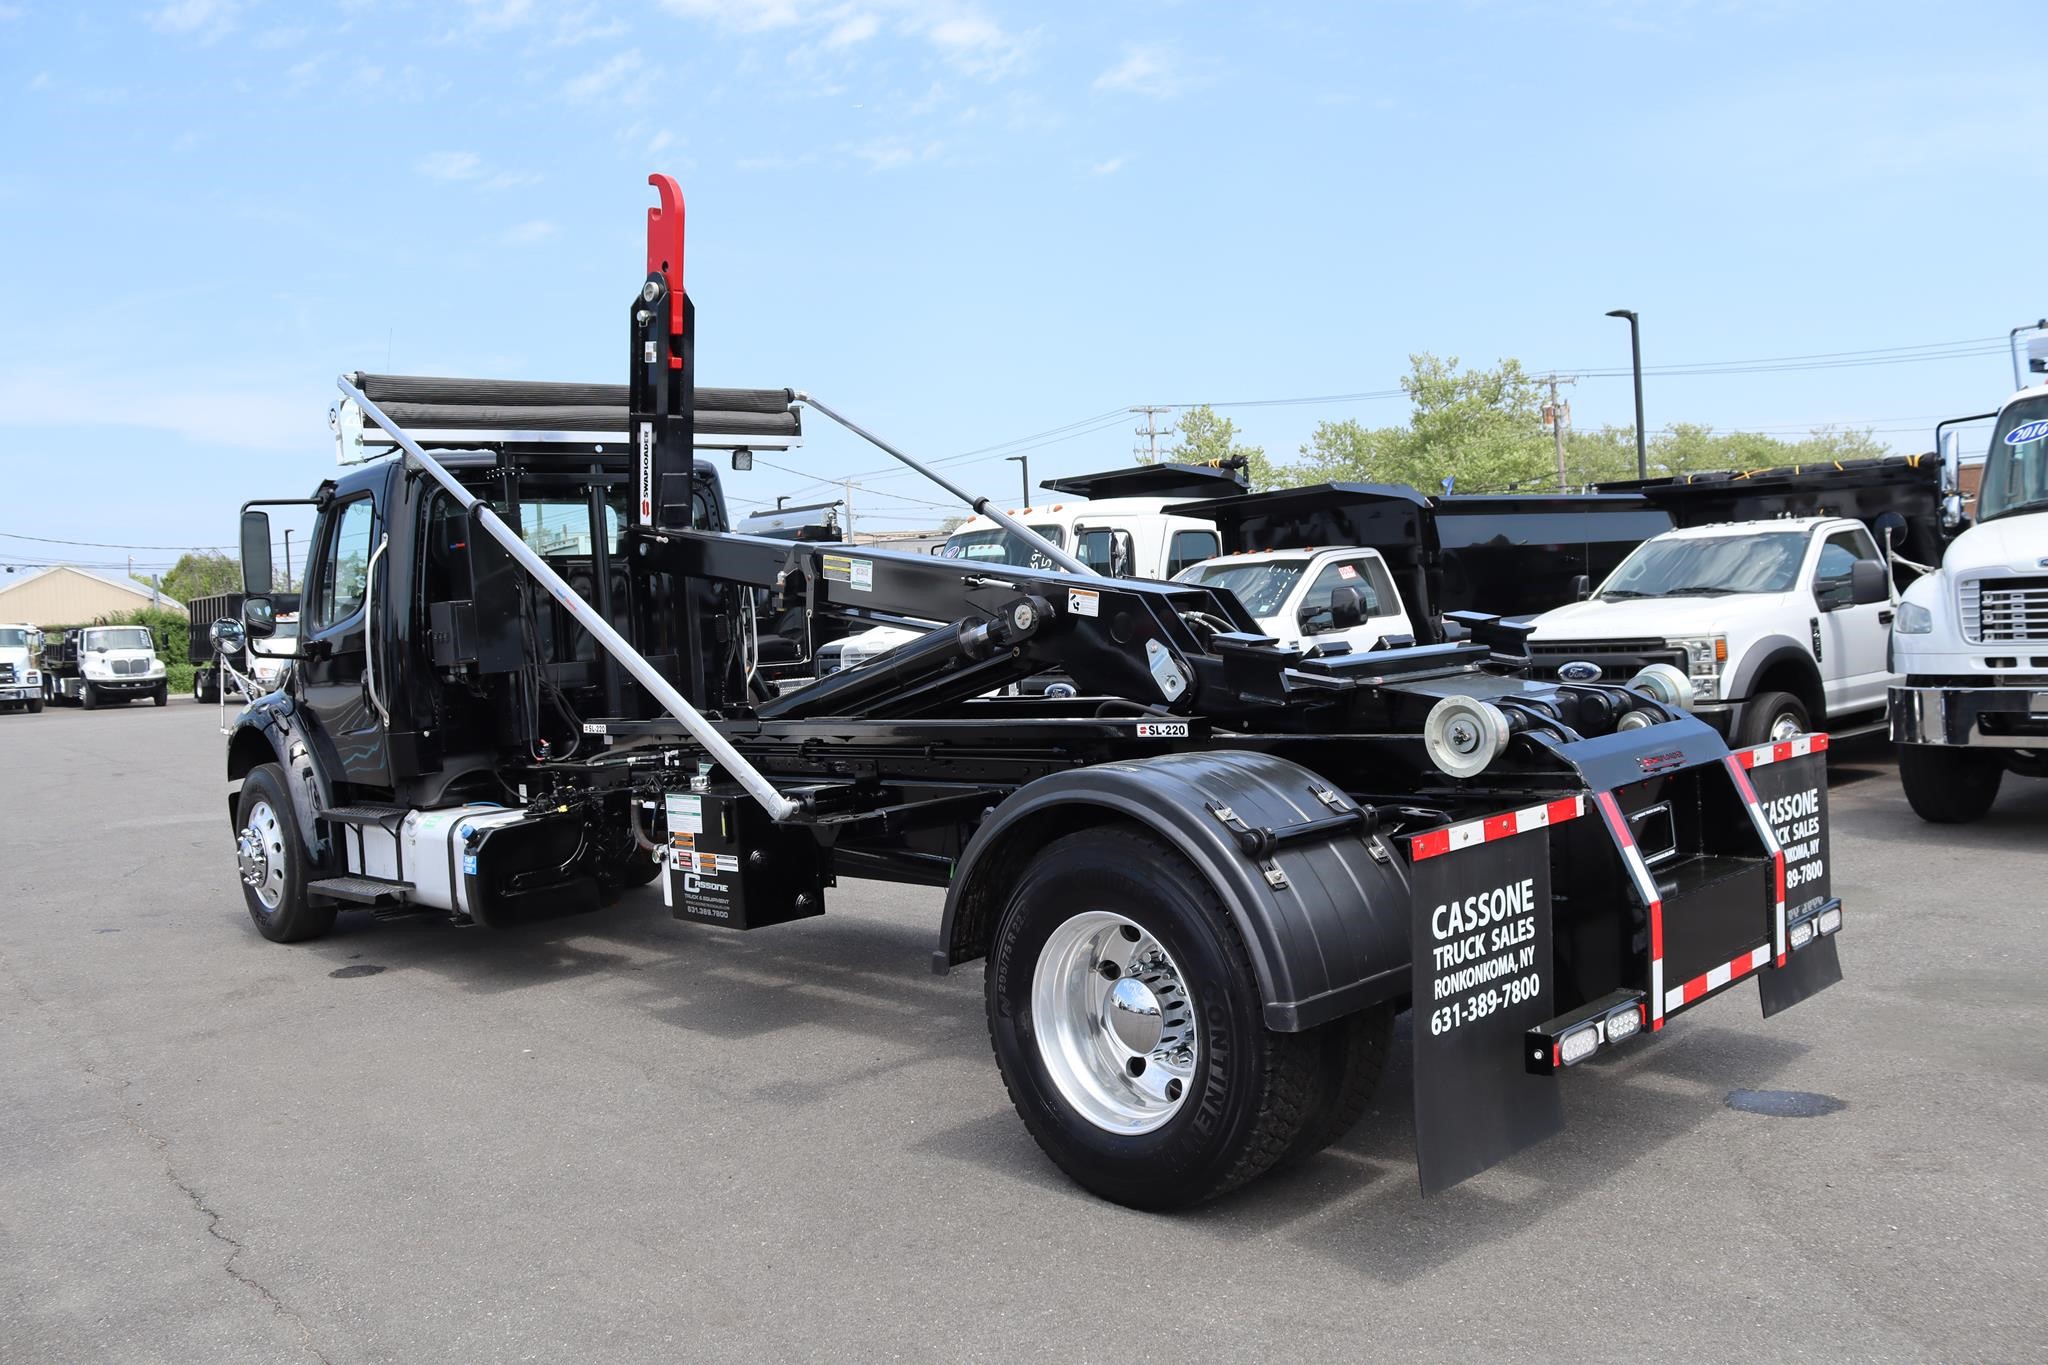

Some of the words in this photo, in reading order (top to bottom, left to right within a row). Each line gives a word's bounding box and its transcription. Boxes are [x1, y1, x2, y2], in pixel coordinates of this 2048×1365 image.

[2012, 422, 2048, 443] 2016
[1568, 667, 1592, 678] Ford
[1148, 725, 1185, 735] SL-220
[1793, 816, 1820, 841] SALES
[1810, 838, 1820, 856] NY
[684, 873, 729, 893] CASSONE
[1786, 860, 1823, 889] 89-7800
[1431, 878, 1535, 941] CASSONE
[1433, 932, 1487, 971] TRUCK
[1491, 916, 1536, 952] SALES
[1434, 952, 1519, 1001] RONKONKOMA,
[1519, 945, 1536, 969] NY
[1431, 973, 1540, 1036] 631-389-7800
